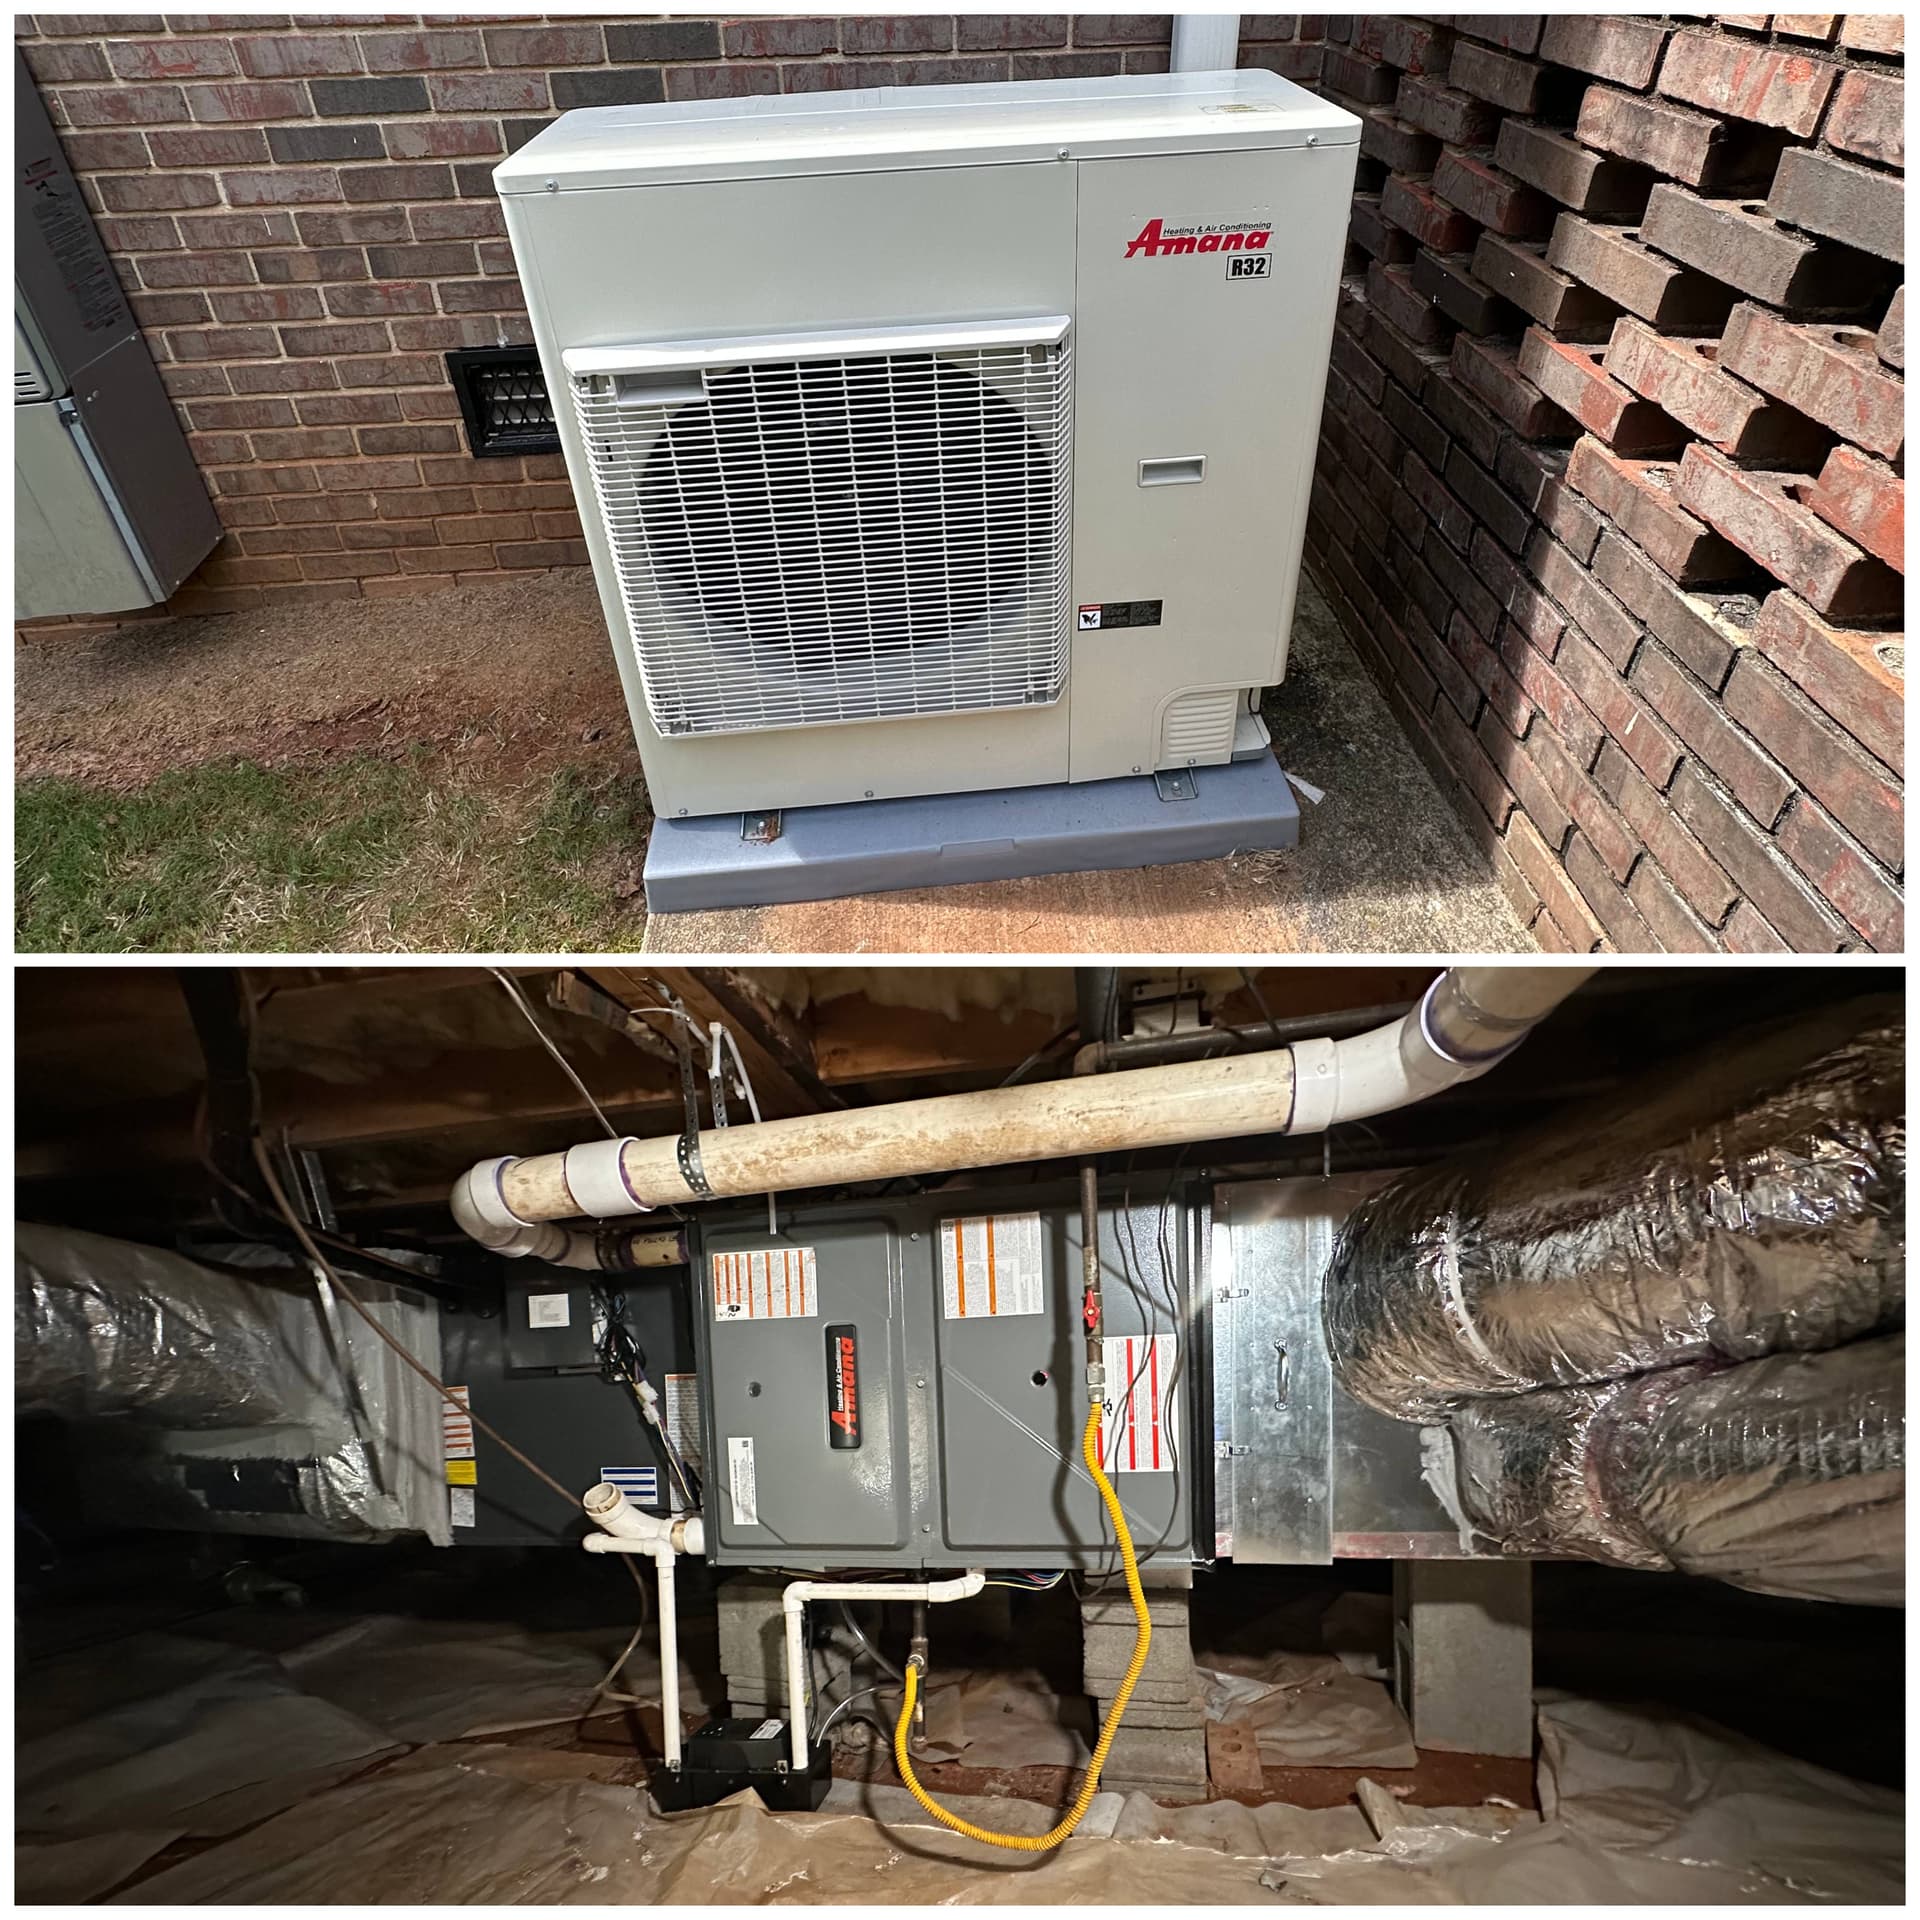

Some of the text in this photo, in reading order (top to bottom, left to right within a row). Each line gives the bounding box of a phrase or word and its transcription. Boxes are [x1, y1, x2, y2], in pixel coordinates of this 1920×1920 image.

[1124, 218, 1272, 259] Amana
[1163, 221, 1272, 236] Heating & Air Conditioning
[1231, 257, 1266, 277] R32
[831, 1336, 857, 1436] Amana
